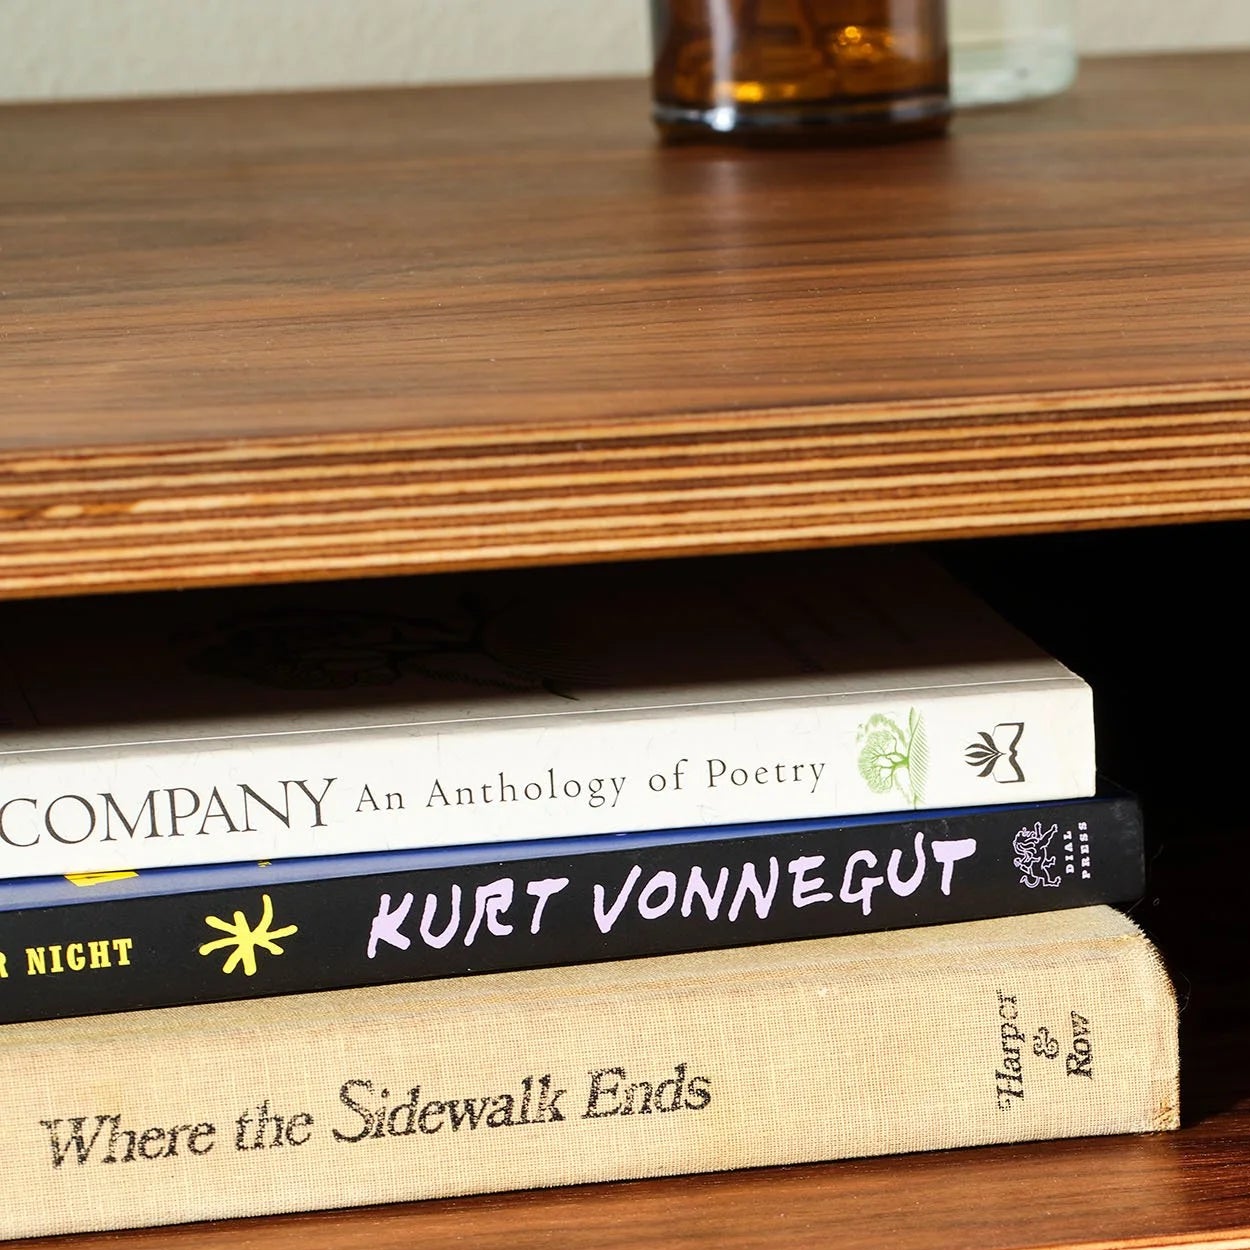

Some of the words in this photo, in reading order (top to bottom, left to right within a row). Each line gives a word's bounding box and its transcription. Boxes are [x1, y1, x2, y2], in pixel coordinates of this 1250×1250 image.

[0, 777, 337, 848] COMPANY
[356, 784, 404, 813] An
[426, 768, 626, 809] Anthology
[648, 758, 689, 792] of
[707, 758, 827, 794] Poetry
[1062, 830, 1075, 874] DIAL
[1077, 821, 1091, 880] PRESS
[367, 877, 569, 959] KURT
[594, 832, 977, 934] VONNEGUT
[25, 937, 133, 976] NIGHT
[995, 988, 1025, 1111] Harper
[1033, 1026, 1059, 1060] &
[1066, 1010, 1092, 1079] Row
[39, 1114, 216, 1169] Where
[235, 1099, 314, 1151] the
[332, 1074, 567, 1143] Sidewalk
[582, 1063, 712, 1119] Ends
